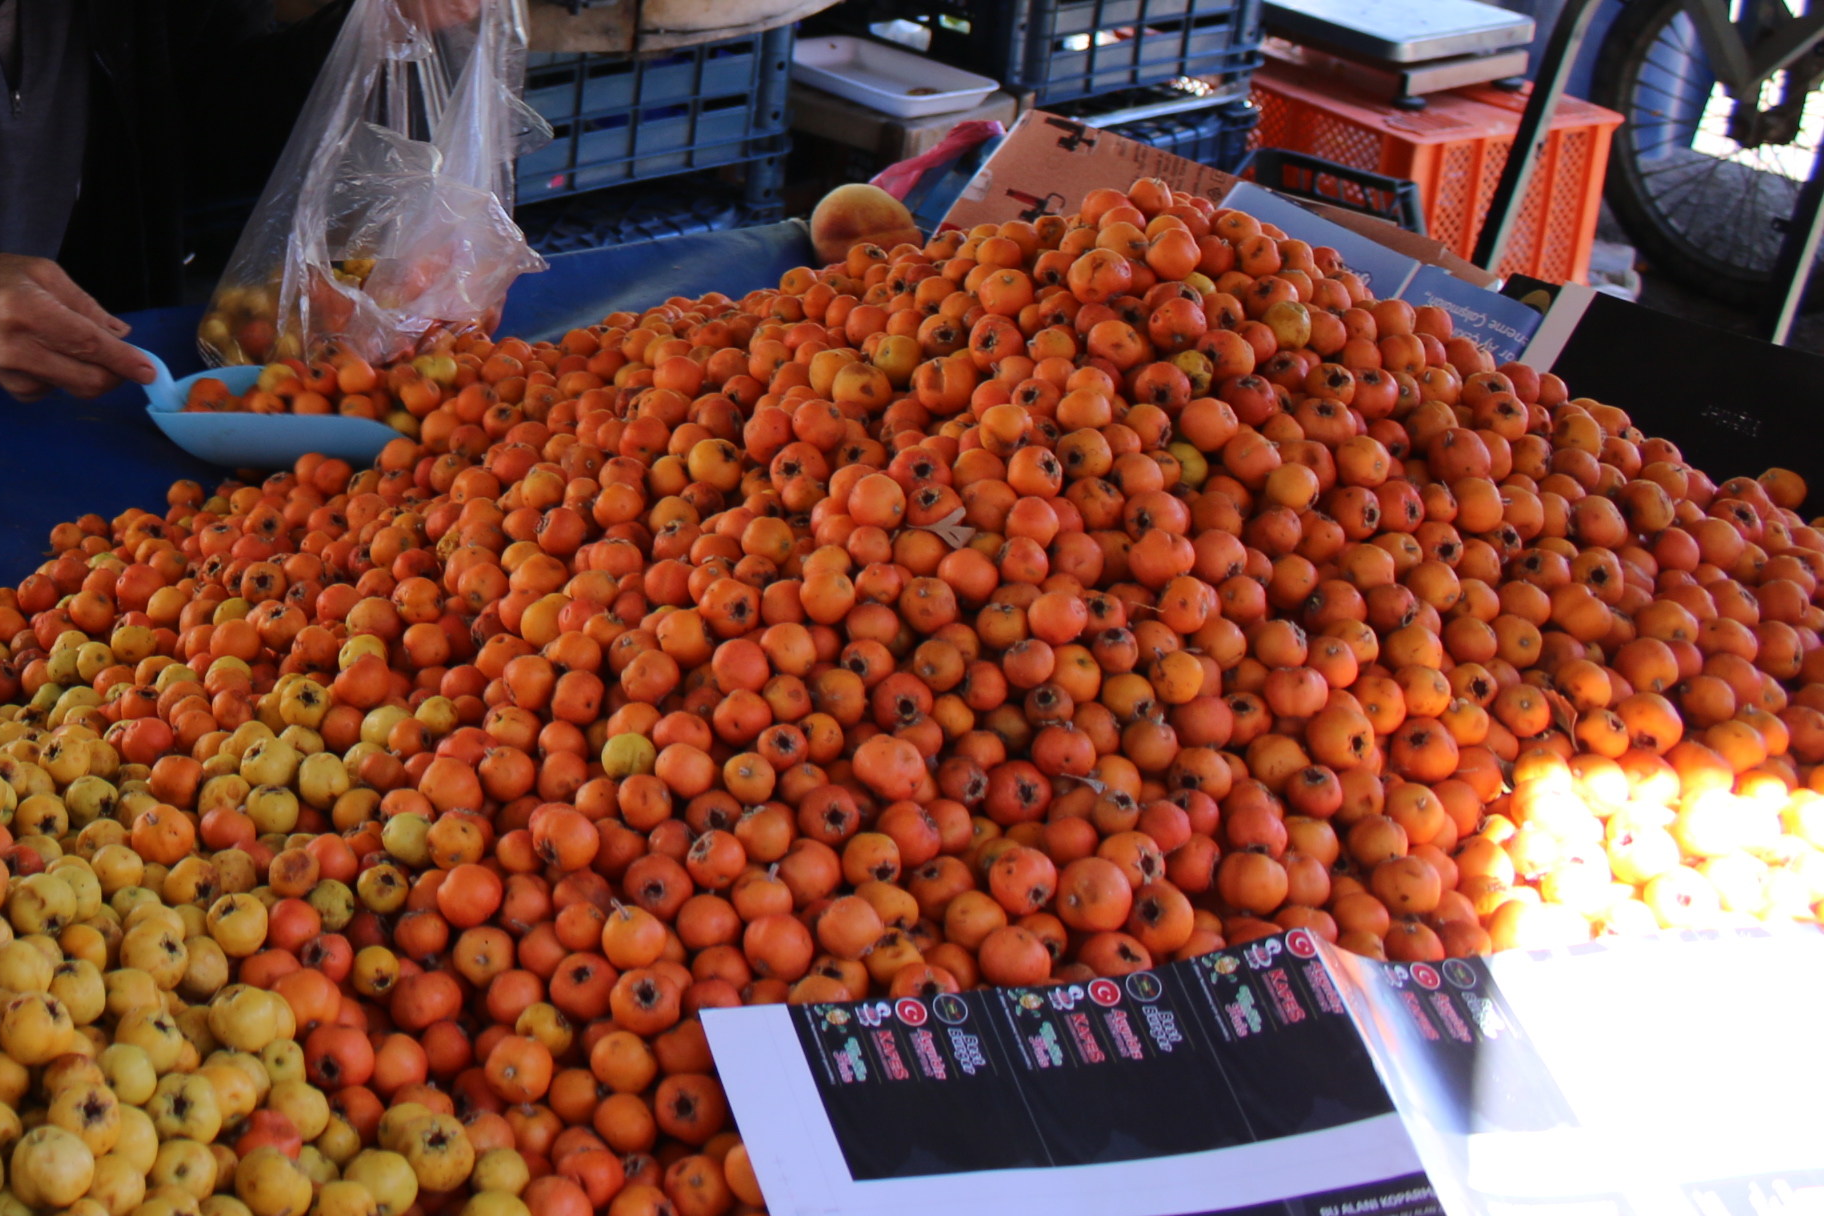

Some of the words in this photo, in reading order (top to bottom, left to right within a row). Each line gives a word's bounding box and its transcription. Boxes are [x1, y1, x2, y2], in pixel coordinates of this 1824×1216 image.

[1268, 967, 1307, 1023] KAFES
[877, 1029, 910, 1080] KAFES
[1071, 1012, 1106, 1064] KAFES
